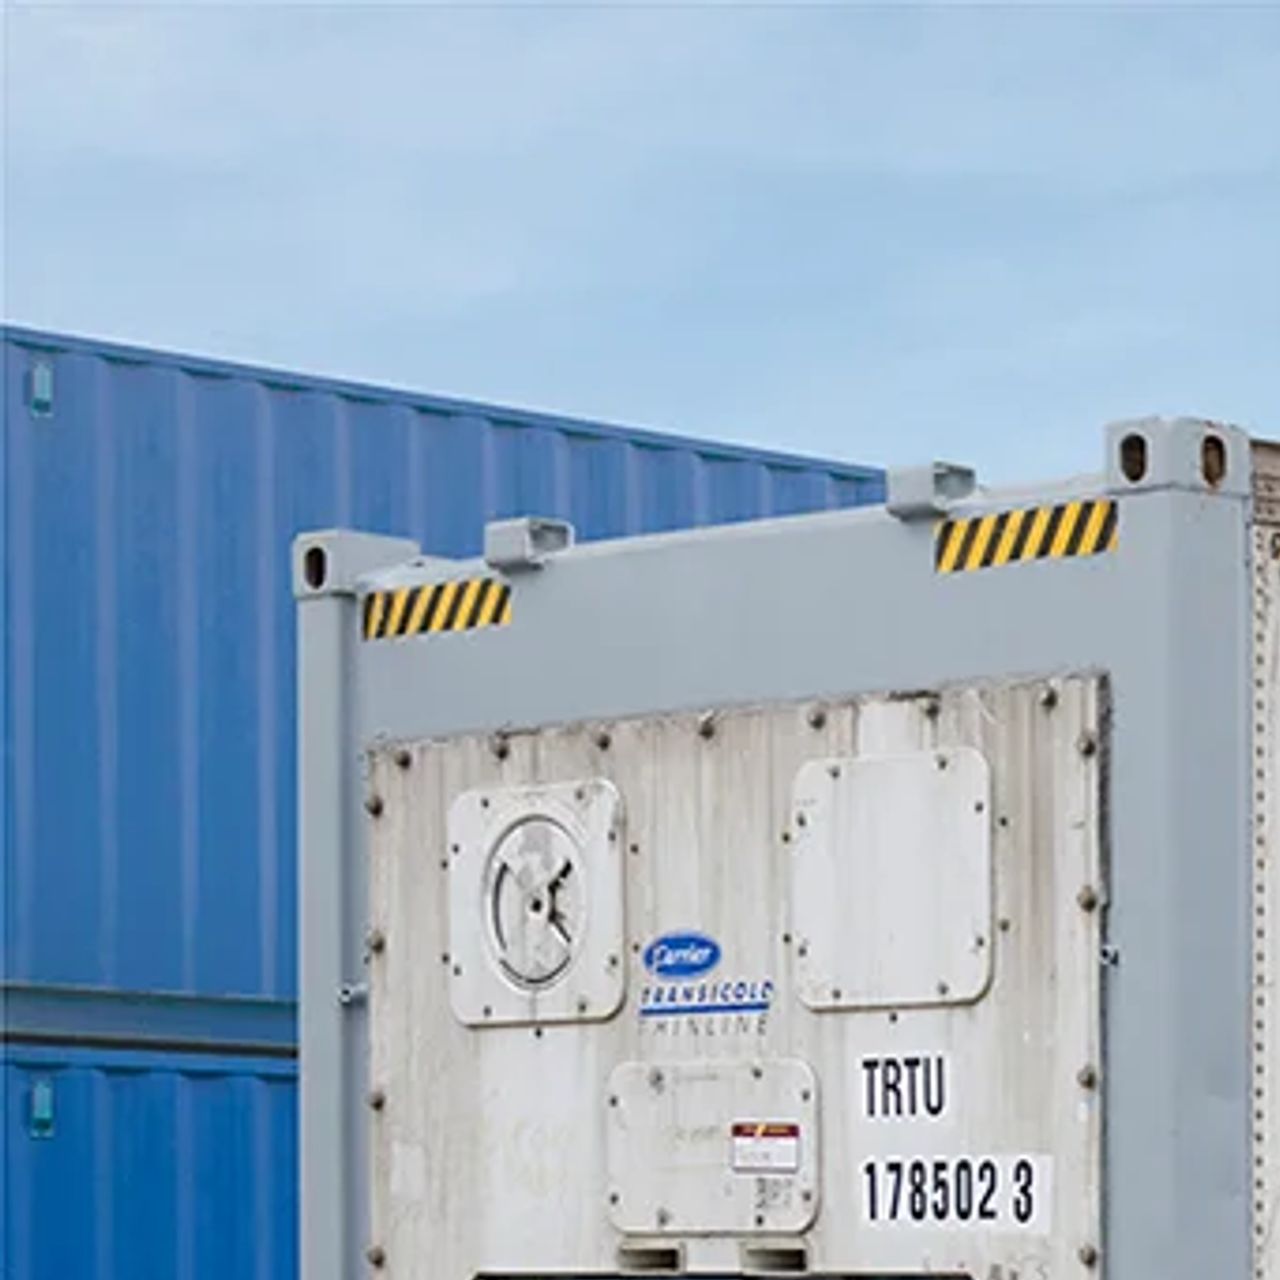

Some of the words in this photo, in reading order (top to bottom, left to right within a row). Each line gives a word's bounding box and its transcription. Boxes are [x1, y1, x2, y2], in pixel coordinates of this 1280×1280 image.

[650, 940, 715, 973] Carrier
[641, 981, 774, 1004] TRANSICOLD
[862, 1056, 946, 1116] TRTU
[864, 1158, 997, 1221] 178502
[1013, 1159, 1034, 1222] 3
